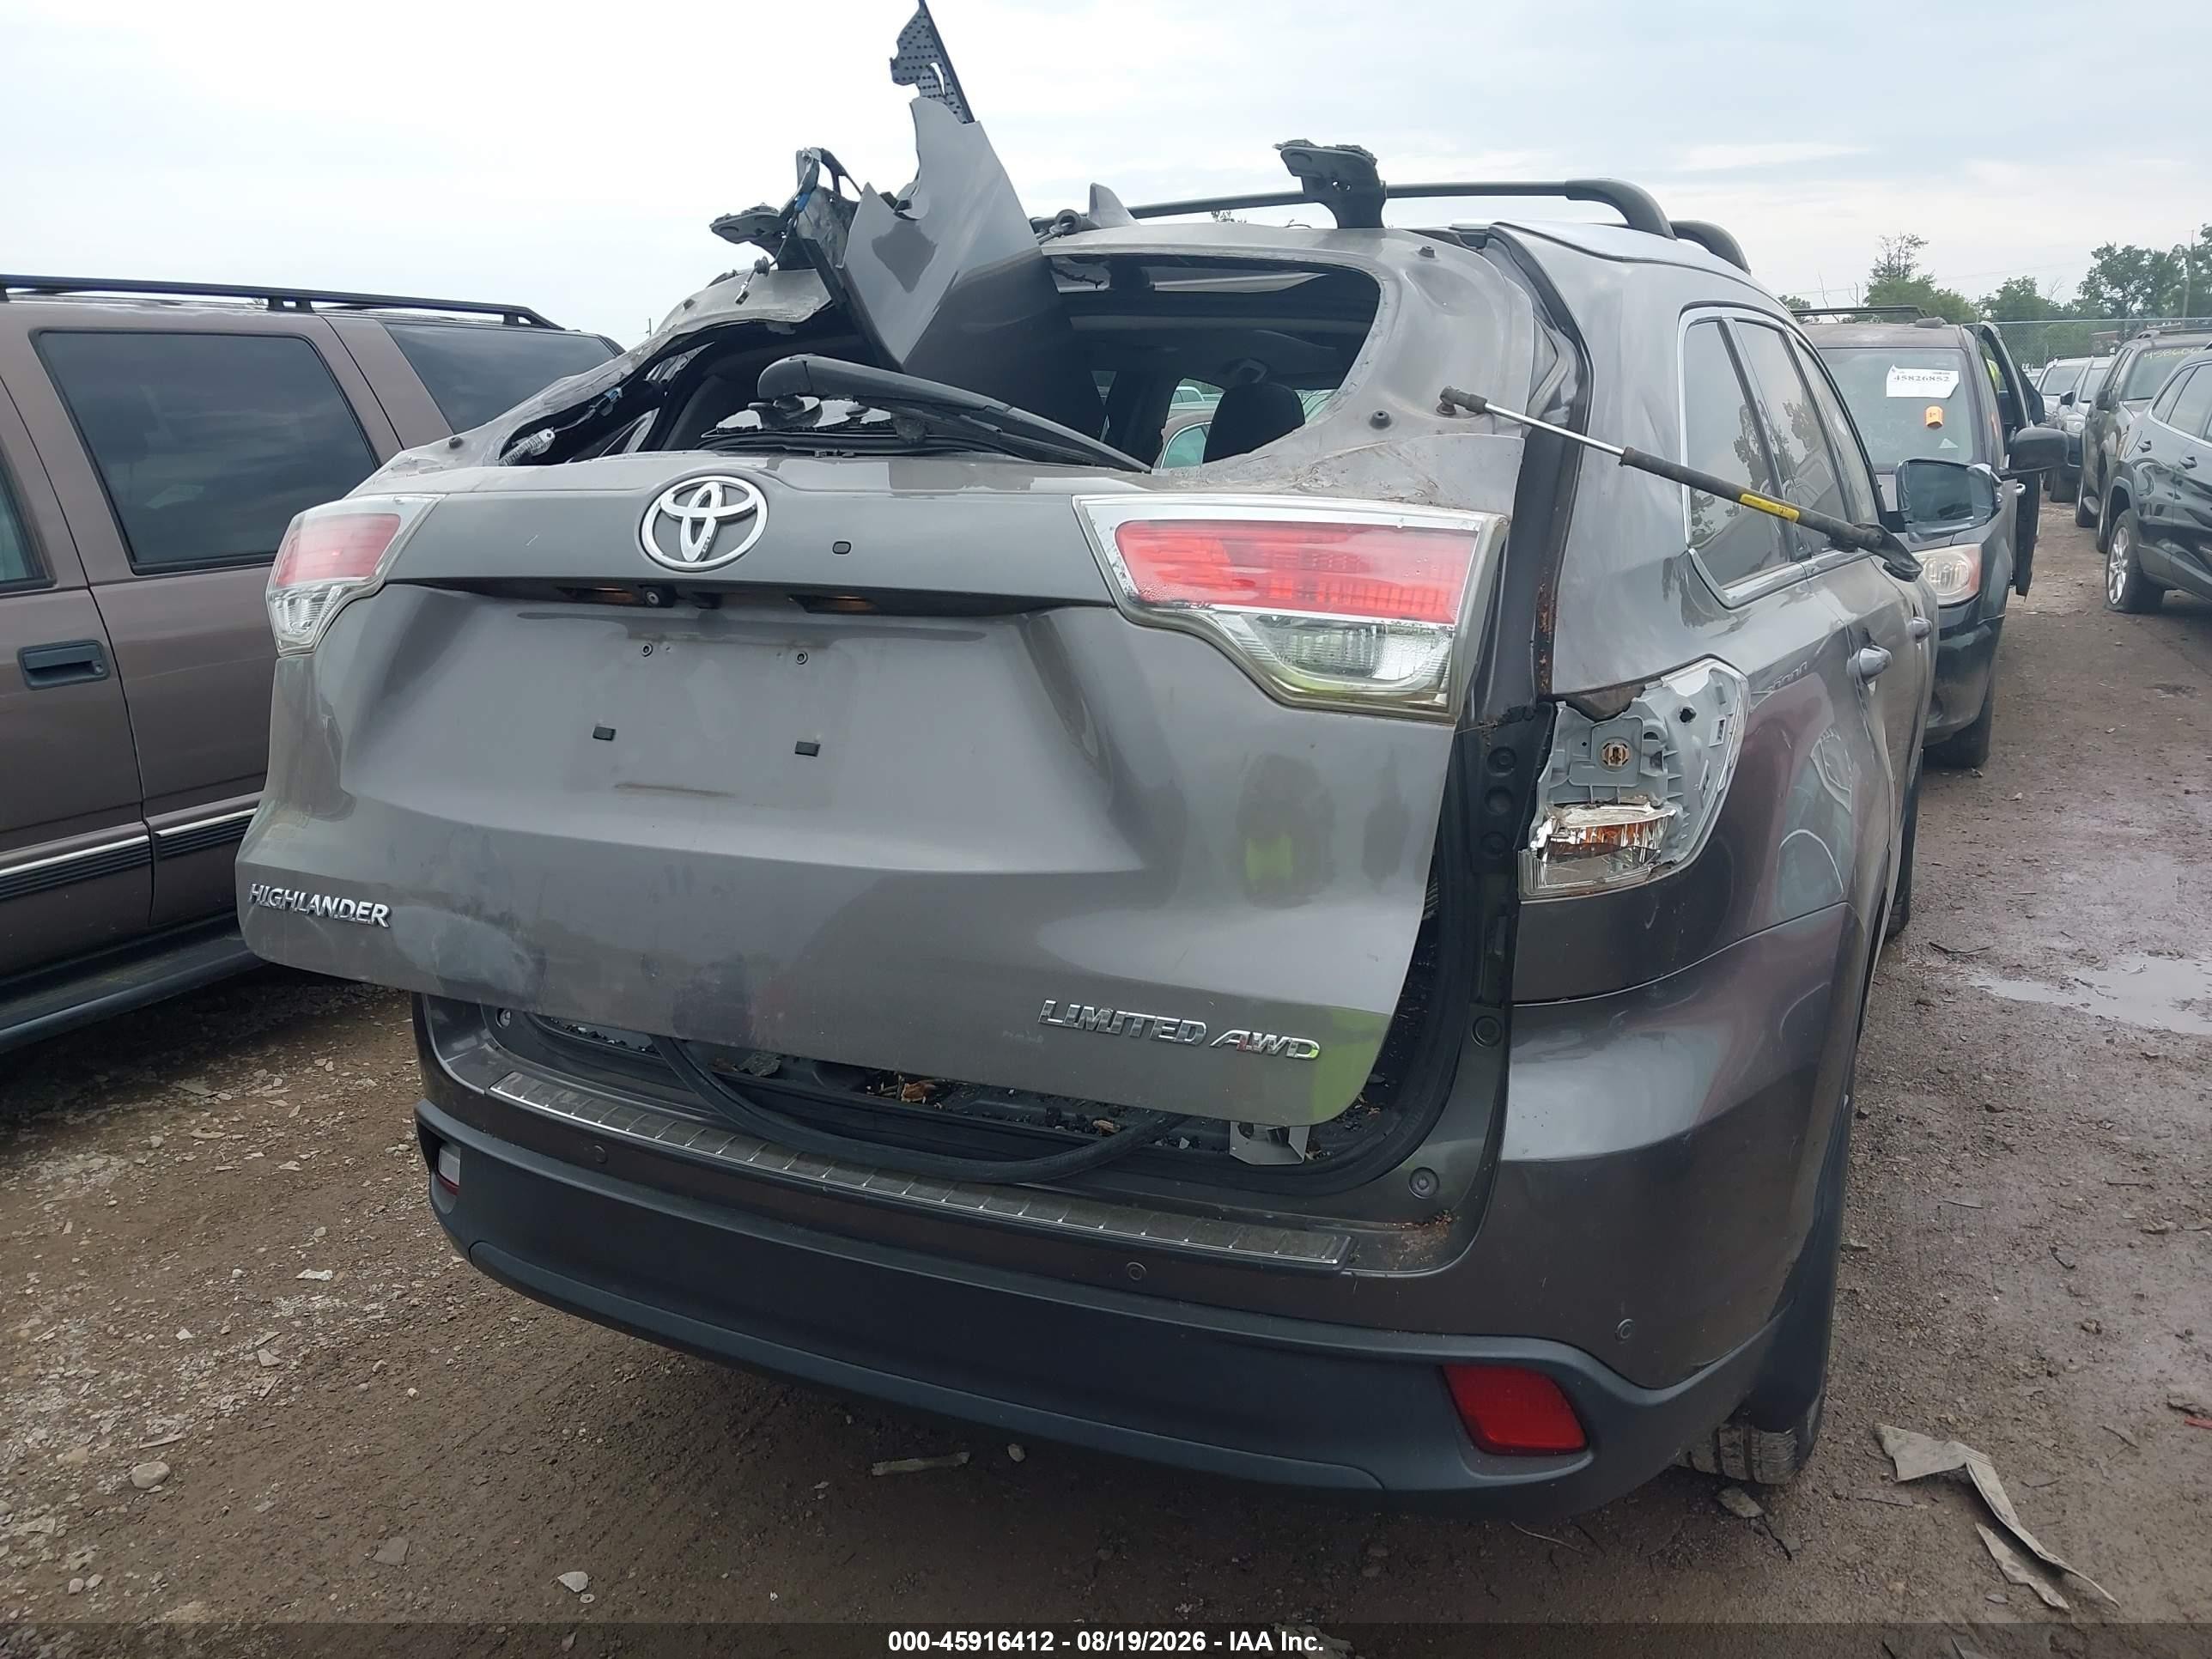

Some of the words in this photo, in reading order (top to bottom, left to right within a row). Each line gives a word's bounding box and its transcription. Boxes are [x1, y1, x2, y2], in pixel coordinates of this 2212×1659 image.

[248, 883, 392, 928] HIGHLANDER
[1037, 1000, 1207, 1047] LIMITED
[1209, 1029, 1321, 1060] AWD
